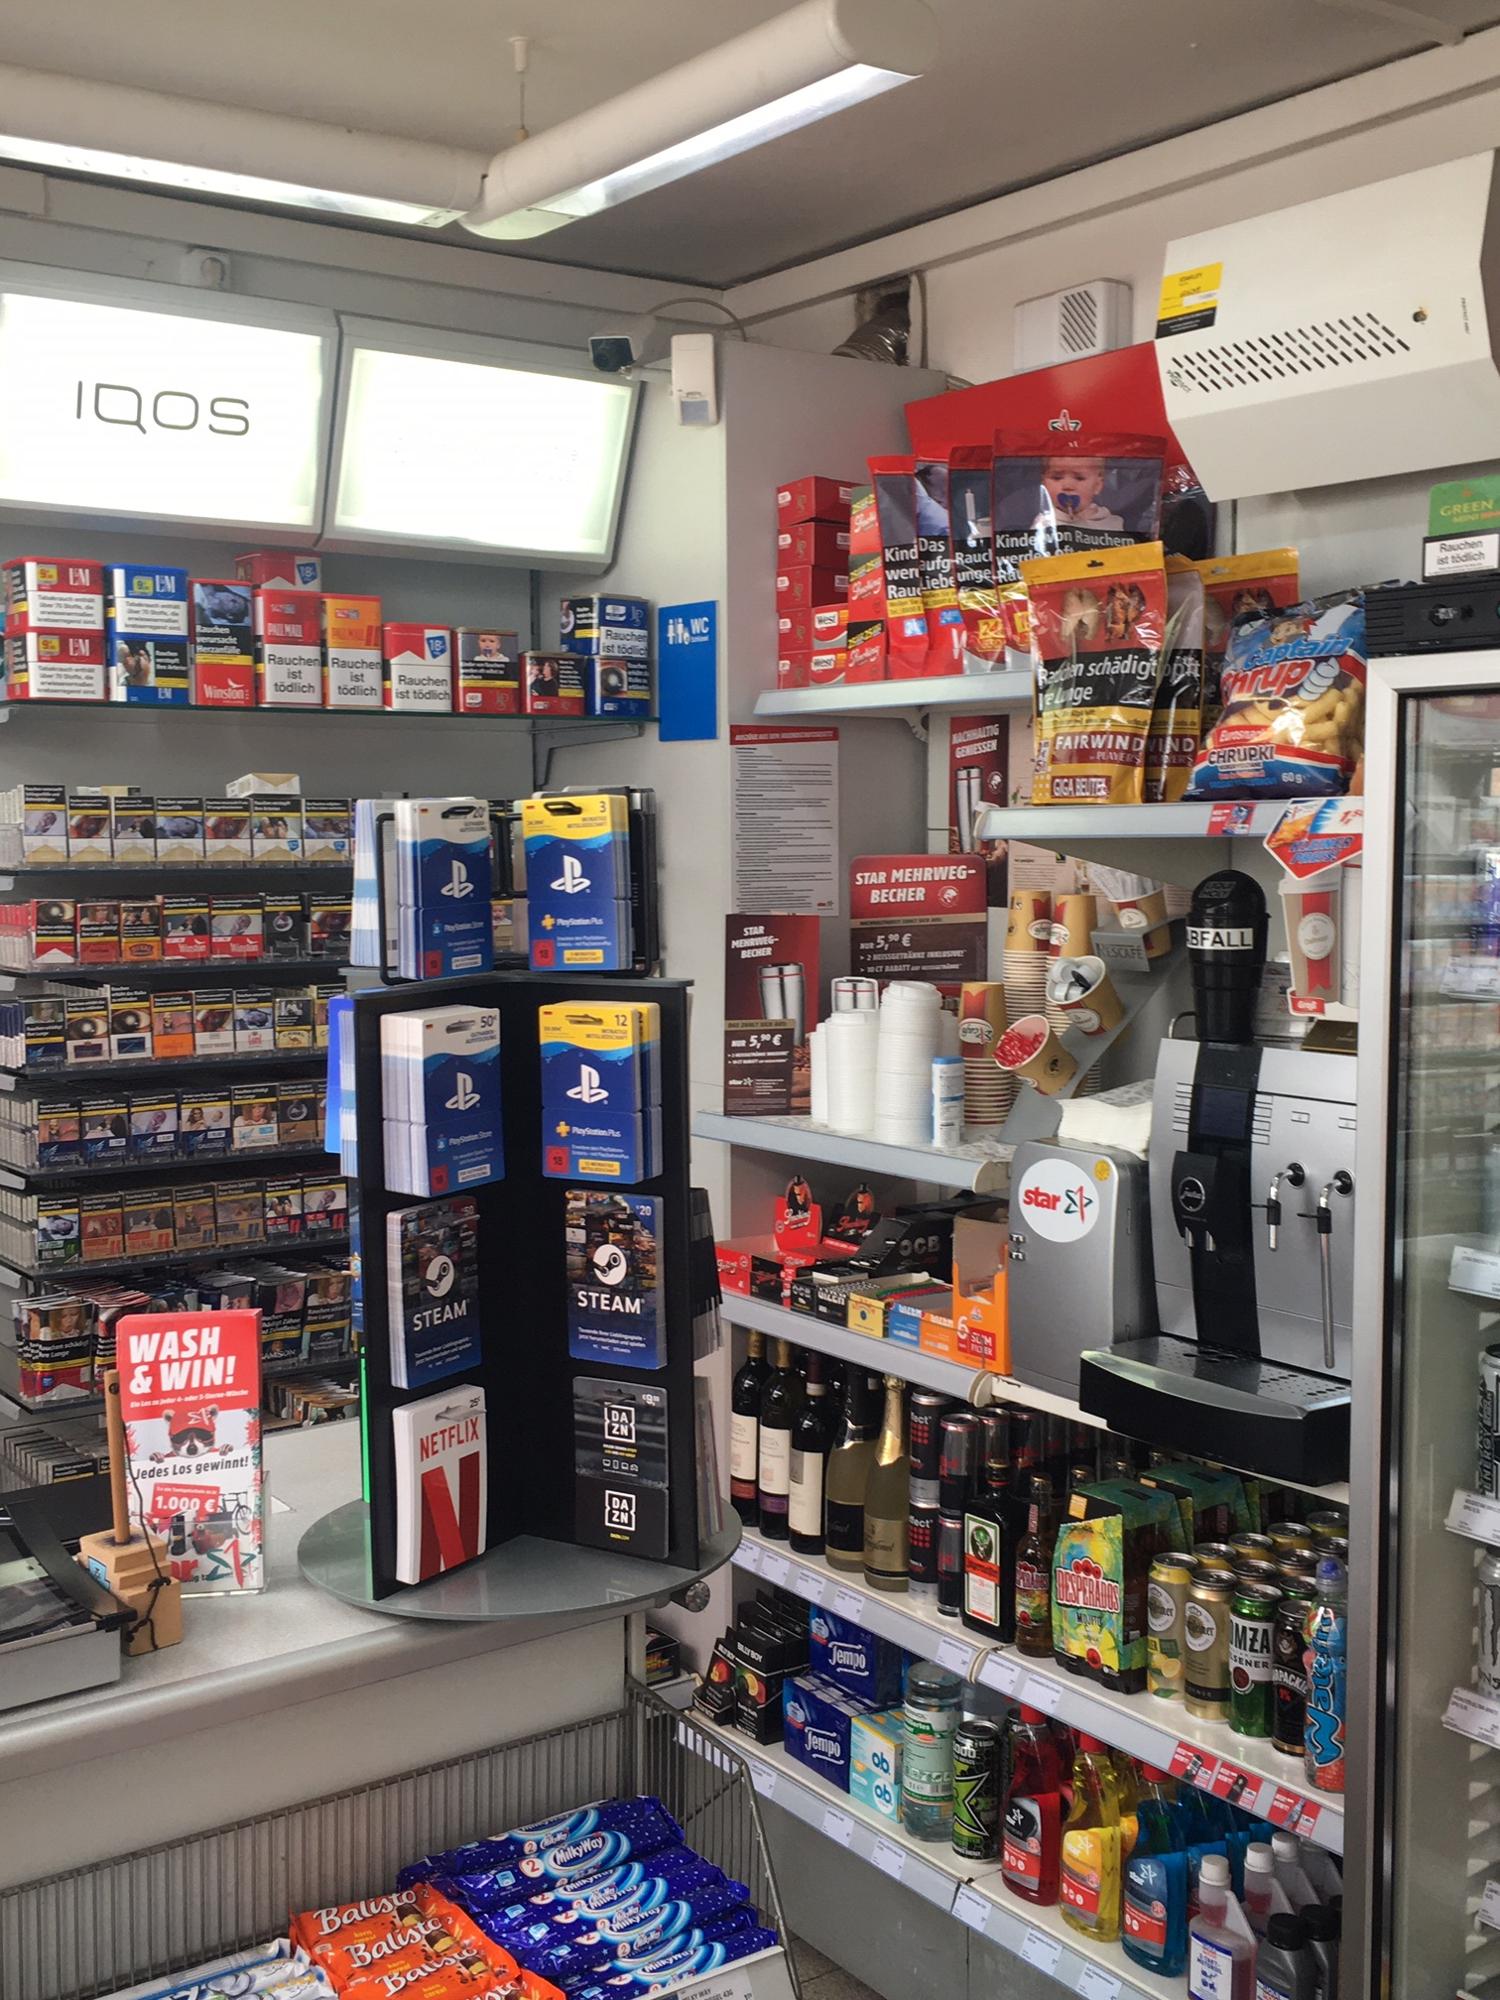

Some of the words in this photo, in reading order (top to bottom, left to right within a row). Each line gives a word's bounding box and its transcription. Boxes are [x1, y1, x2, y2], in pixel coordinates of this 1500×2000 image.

[77, 380, 249, 436] IQOS
[919, 537, 945, 552] Das
[997, 533, 1035, 549] Kinde
[690, 617, 710, 635] WC
[602, 644, 616, 653] ist
[1243, 636, 1354, 670] Captain
[268, 654, 321, 667] Rauchen
[331, 657, 381, 670] Rauchen
[1086, 655, 1158, 681] schädigt
[287, 668, 302, 680] ist
[349, 671, 365, 684] ist
[398, 675, 448, 688] Rauchen
[204, 683, 245, 700] Winston
[274, 682, 316, 694] tödlich
[337, 684, 378, 697] tödlich
[395, 690, 410, 700] ist
[412, 689, 450, 701] tödlich
[1055, 734, 1146, 751] FAIRWIND
[599, 800, 607, 813] 3
[855, 871, 887, 886] STAR
[890, 865, 976, 883] MEHRWEG-
[870, 887, 926, 904] BECHER
[743, 925, 765, 936] STAR
[901, 933, 912, 947] €
[740, 947, 773, 959] BECHER
[614, 1014, 628, 1027] 12
[772, 1034, 782, 1046] €
[1023, 1187, 1062, 1212] star
[900, 1235, 940, 1257] OCB
[577, 1290, 641, 1315] STEAM
[412, 1300, 468, 1331] STEAM
[956, 1316, 969, 1340] 6
[128, 1326, 221, 1364] WASH
[129, 1366, 153, 1395] &
[159, 1355, 237, 1393] WIN!
[420, 1416, 480, 1462] NETFLIX
[134, 1466, 169, 1480] Jedes
[172, 1464, 192, 1476] Los
[195, 1456, 249, 1475] gewinnt!
[155, 1495, 200, 1510] 1.000
[204, 1499, 216, 1513] €
[1057, 1569, 1121, 1613] DESPERADOS
[556, 1836, 603, 1866] MilkyWay
[528, 1859, 539, 1873] 2
[313, 1889, 416, 1936] Balisto
[342, 1917, 443, 1969] Balisto
[374, 1948, 478, 1998] Balisto
